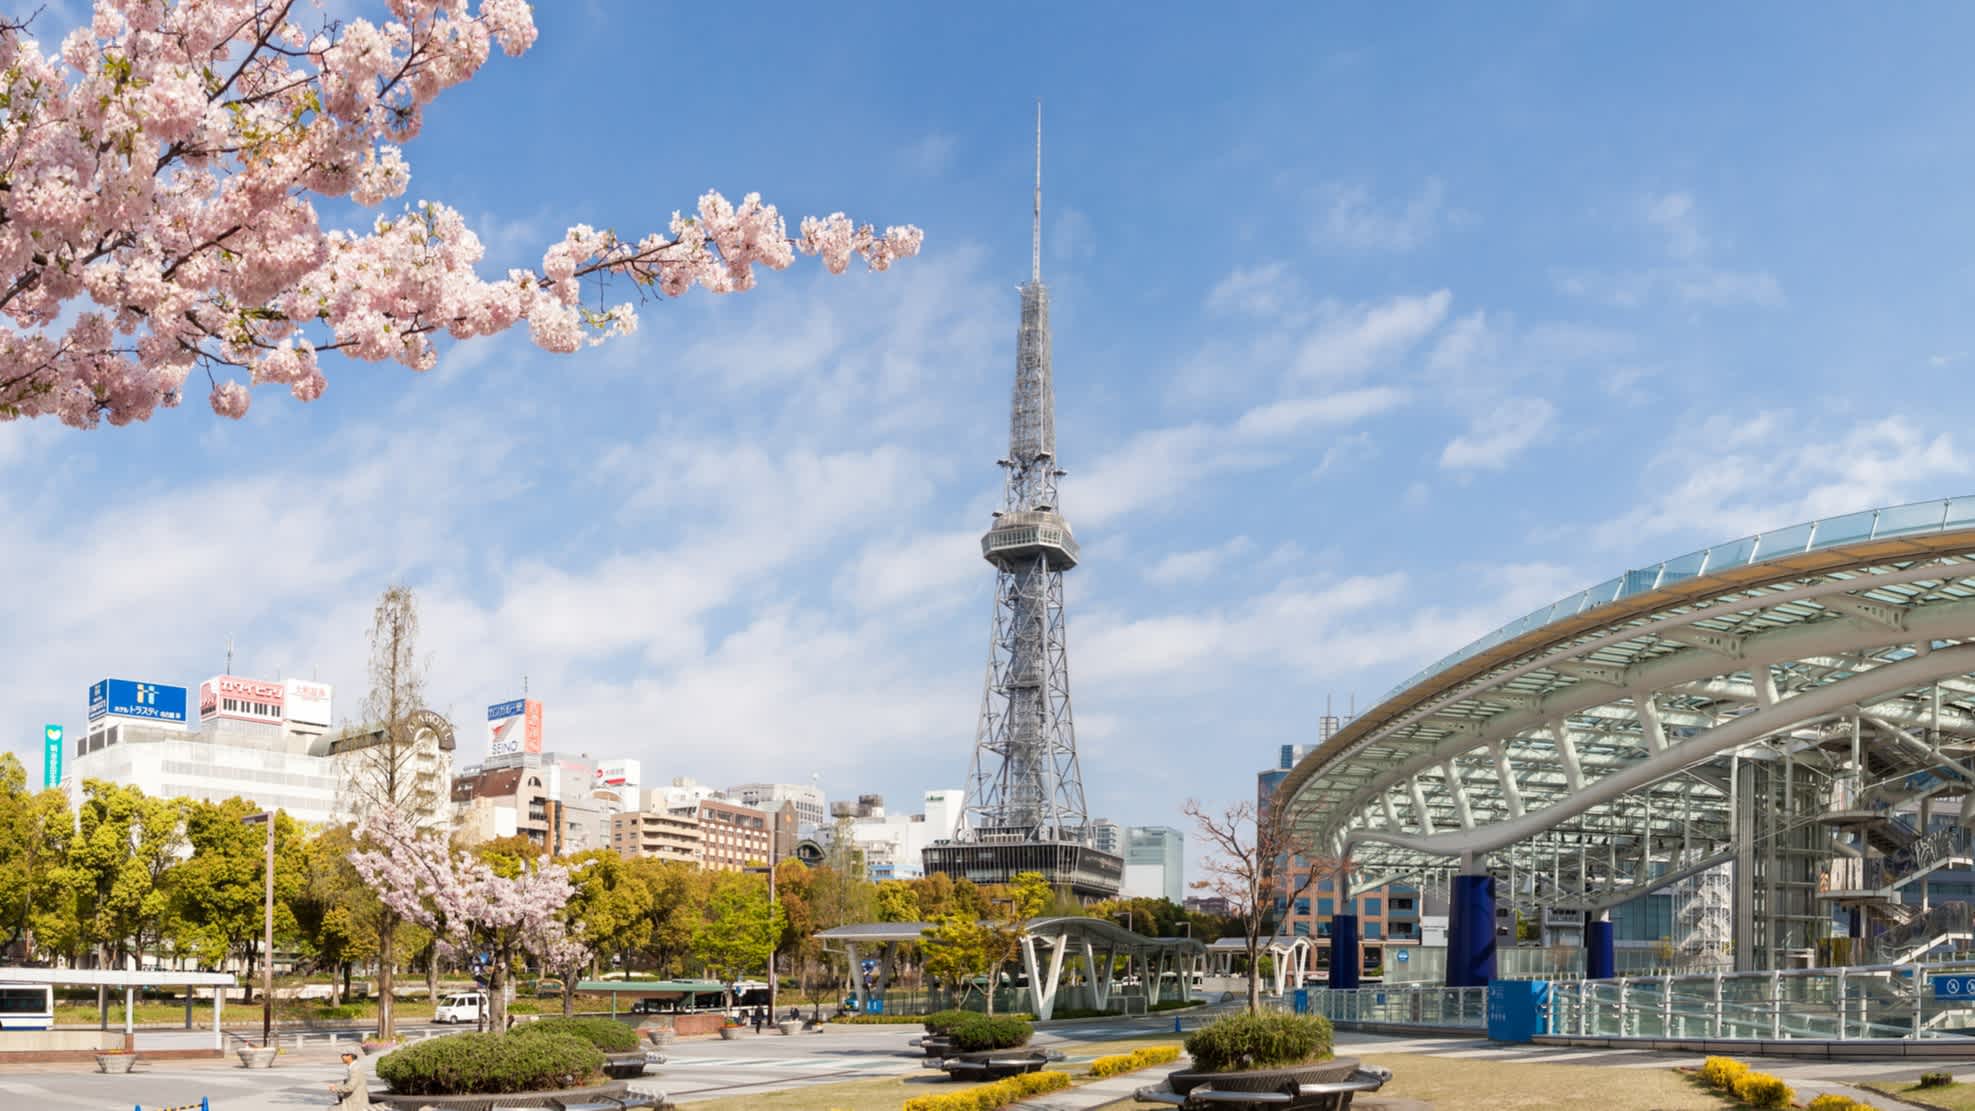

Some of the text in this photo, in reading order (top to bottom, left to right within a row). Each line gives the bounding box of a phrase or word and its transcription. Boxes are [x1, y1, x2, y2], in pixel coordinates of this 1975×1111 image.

[130, 705, 159, 716] トラスティ
